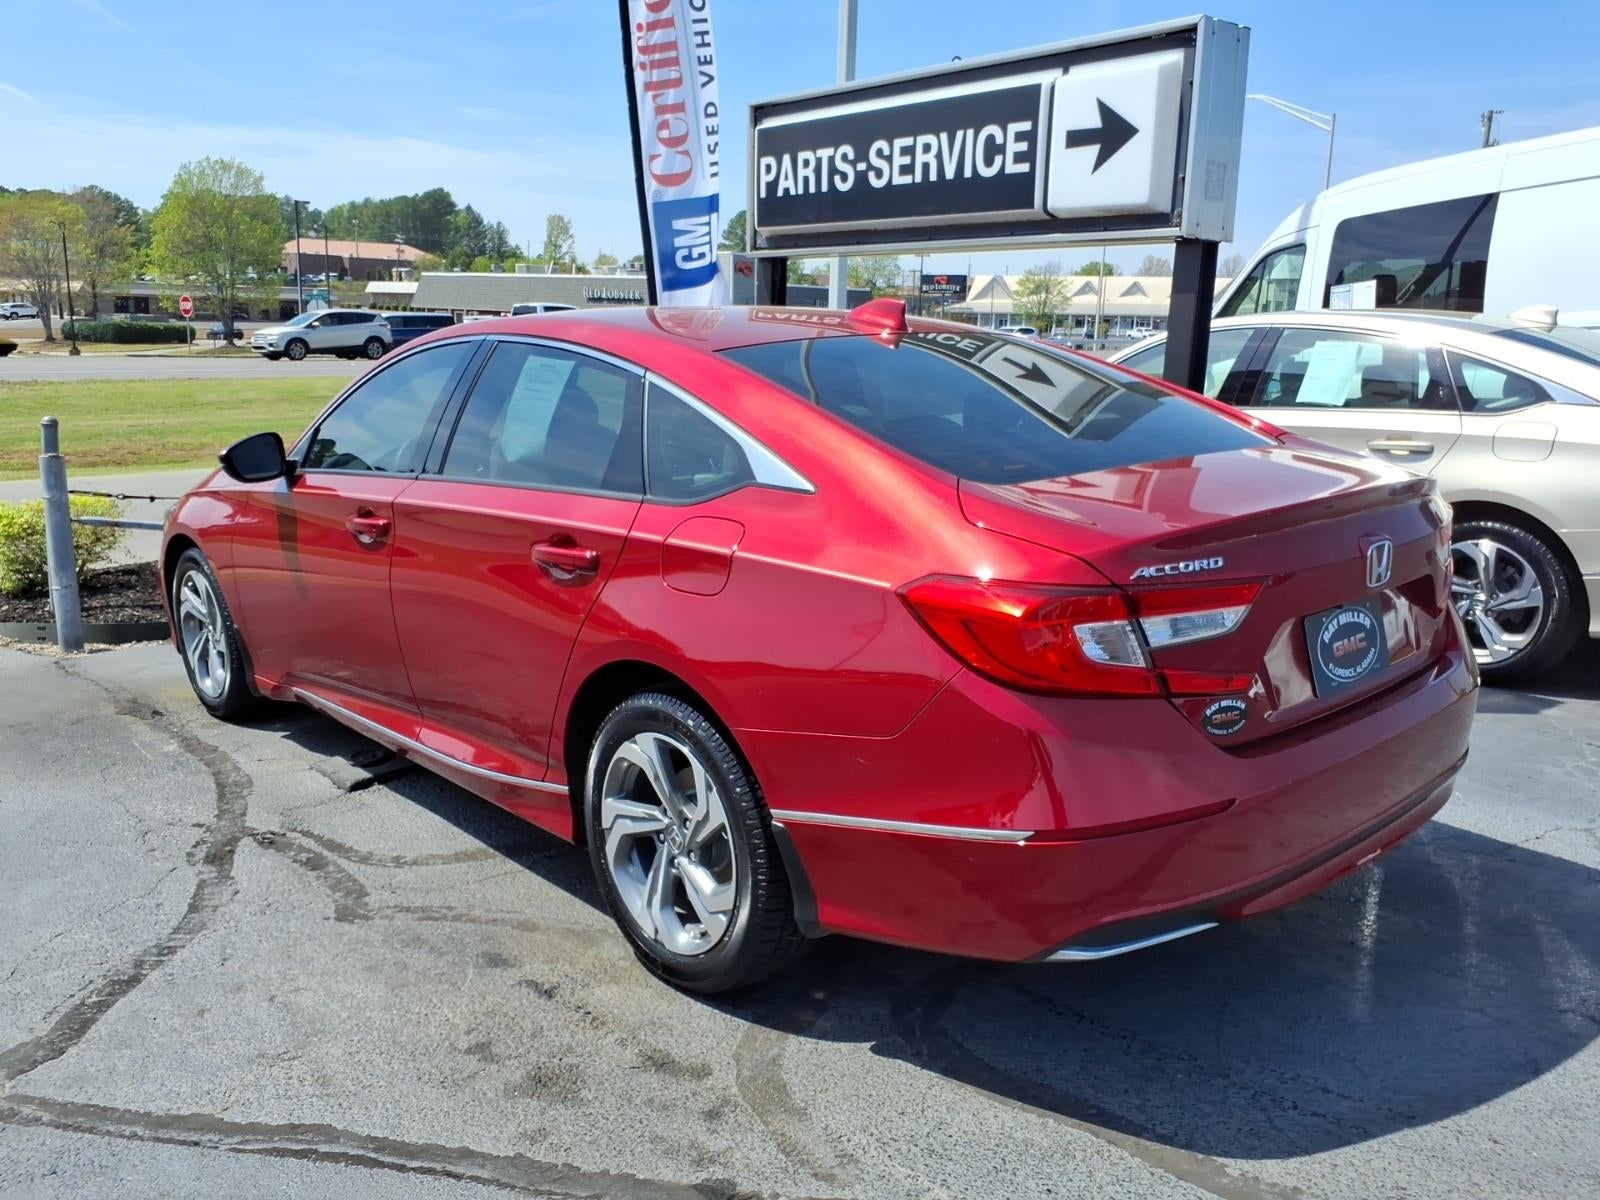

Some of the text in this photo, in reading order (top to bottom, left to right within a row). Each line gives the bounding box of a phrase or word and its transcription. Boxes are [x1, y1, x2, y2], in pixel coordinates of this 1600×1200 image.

[759, 121, 1033, 199] PARTS-SERVICE
[672, 215, 711, 270] GM
[583, 287, 641, 300] RED LOBSTER
[1129, 557, 1223, 580] ACCORD
[1323, 611, 1371, 644] RAY MILLER
[1333, 632, 1367, 657] GMC
[1205, 699, 1245, 716] RAY MILLER
[1212, 711, 1240, 723] GMC
